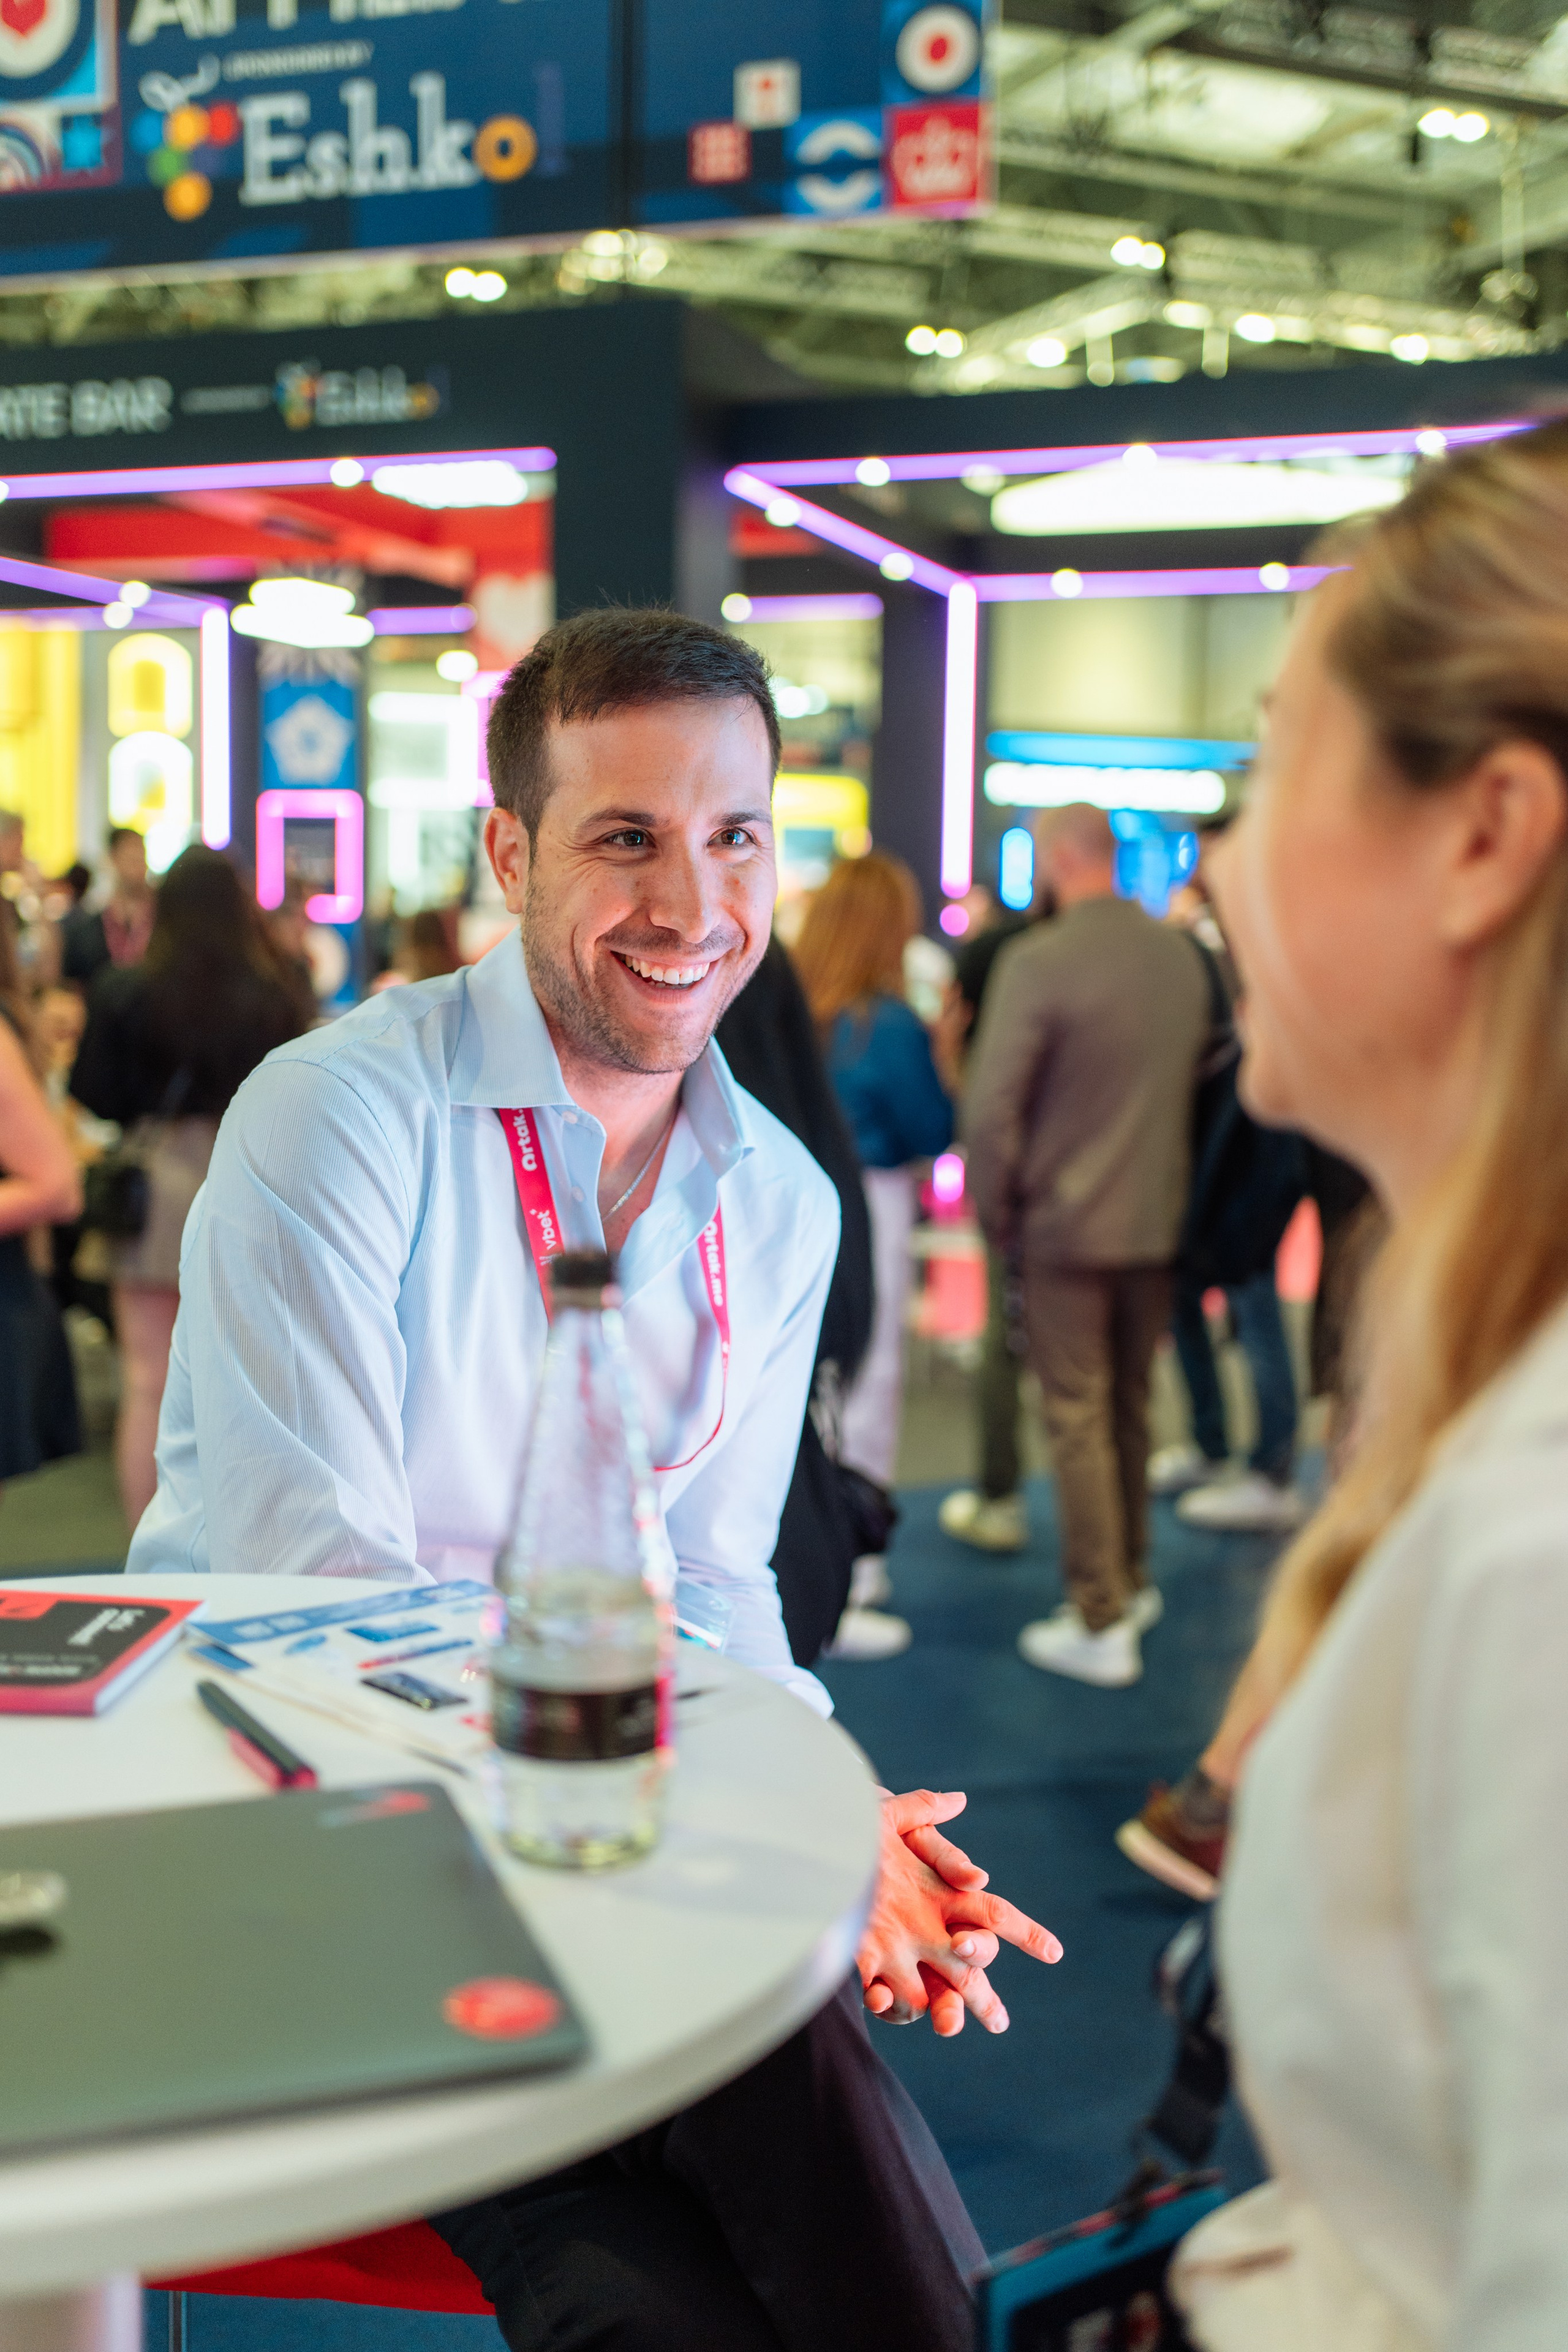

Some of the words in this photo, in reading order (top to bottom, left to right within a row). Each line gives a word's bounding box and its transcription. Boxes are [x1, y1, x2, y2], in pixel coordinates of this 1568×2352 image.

[238, 70, 539, 207] Eshko
[71, 376, 172, 435] BAR
[513, 1108, 538, 1171] Ortak.
[537, 1210, 557, 1250] vbet
[704, 1220, 724, 1306] Ortak.me
